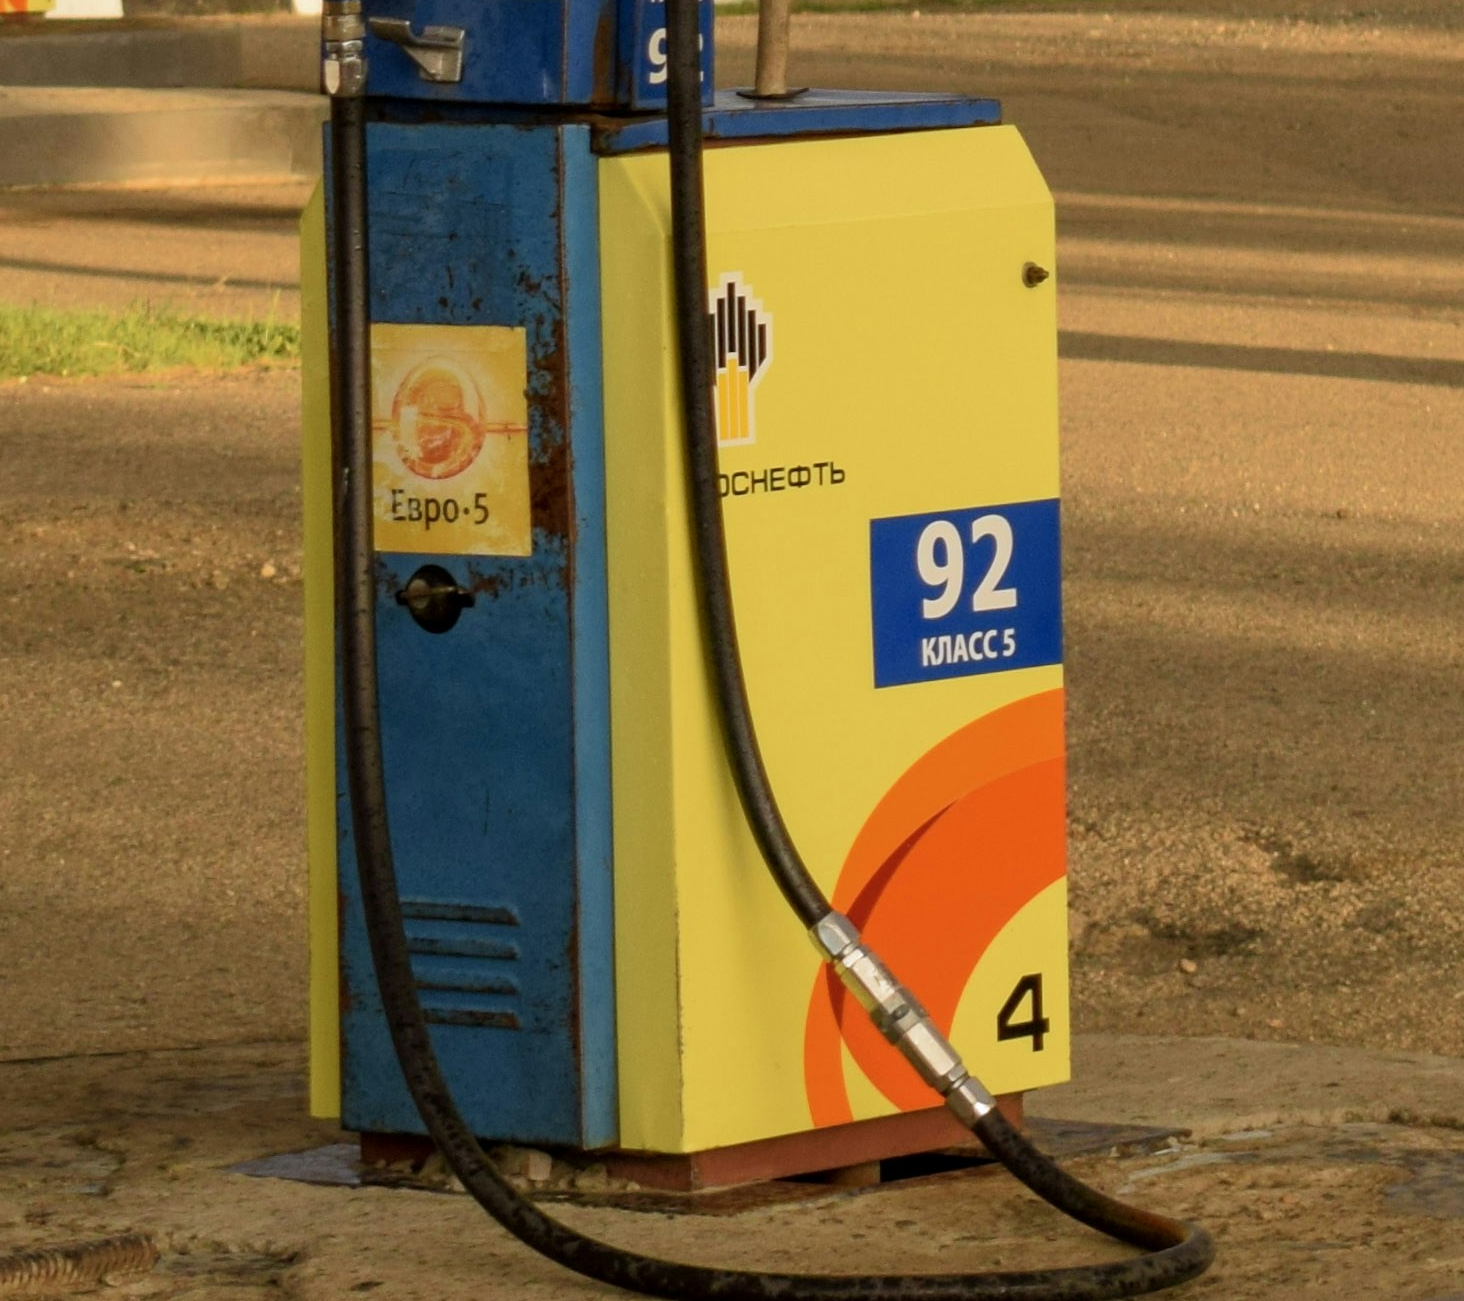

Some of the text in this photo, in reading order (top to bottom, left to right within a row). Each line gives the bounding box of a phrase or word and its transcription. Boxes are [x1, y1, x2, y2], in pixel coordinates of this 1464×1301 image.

[718, 461, 846, 497] ОСНЕФТЬ
[916, 514, 1018, 620] 92
[921, 628, 1016, 667] КЛАСС 5
[997, 972, 1050, 1052] 4
